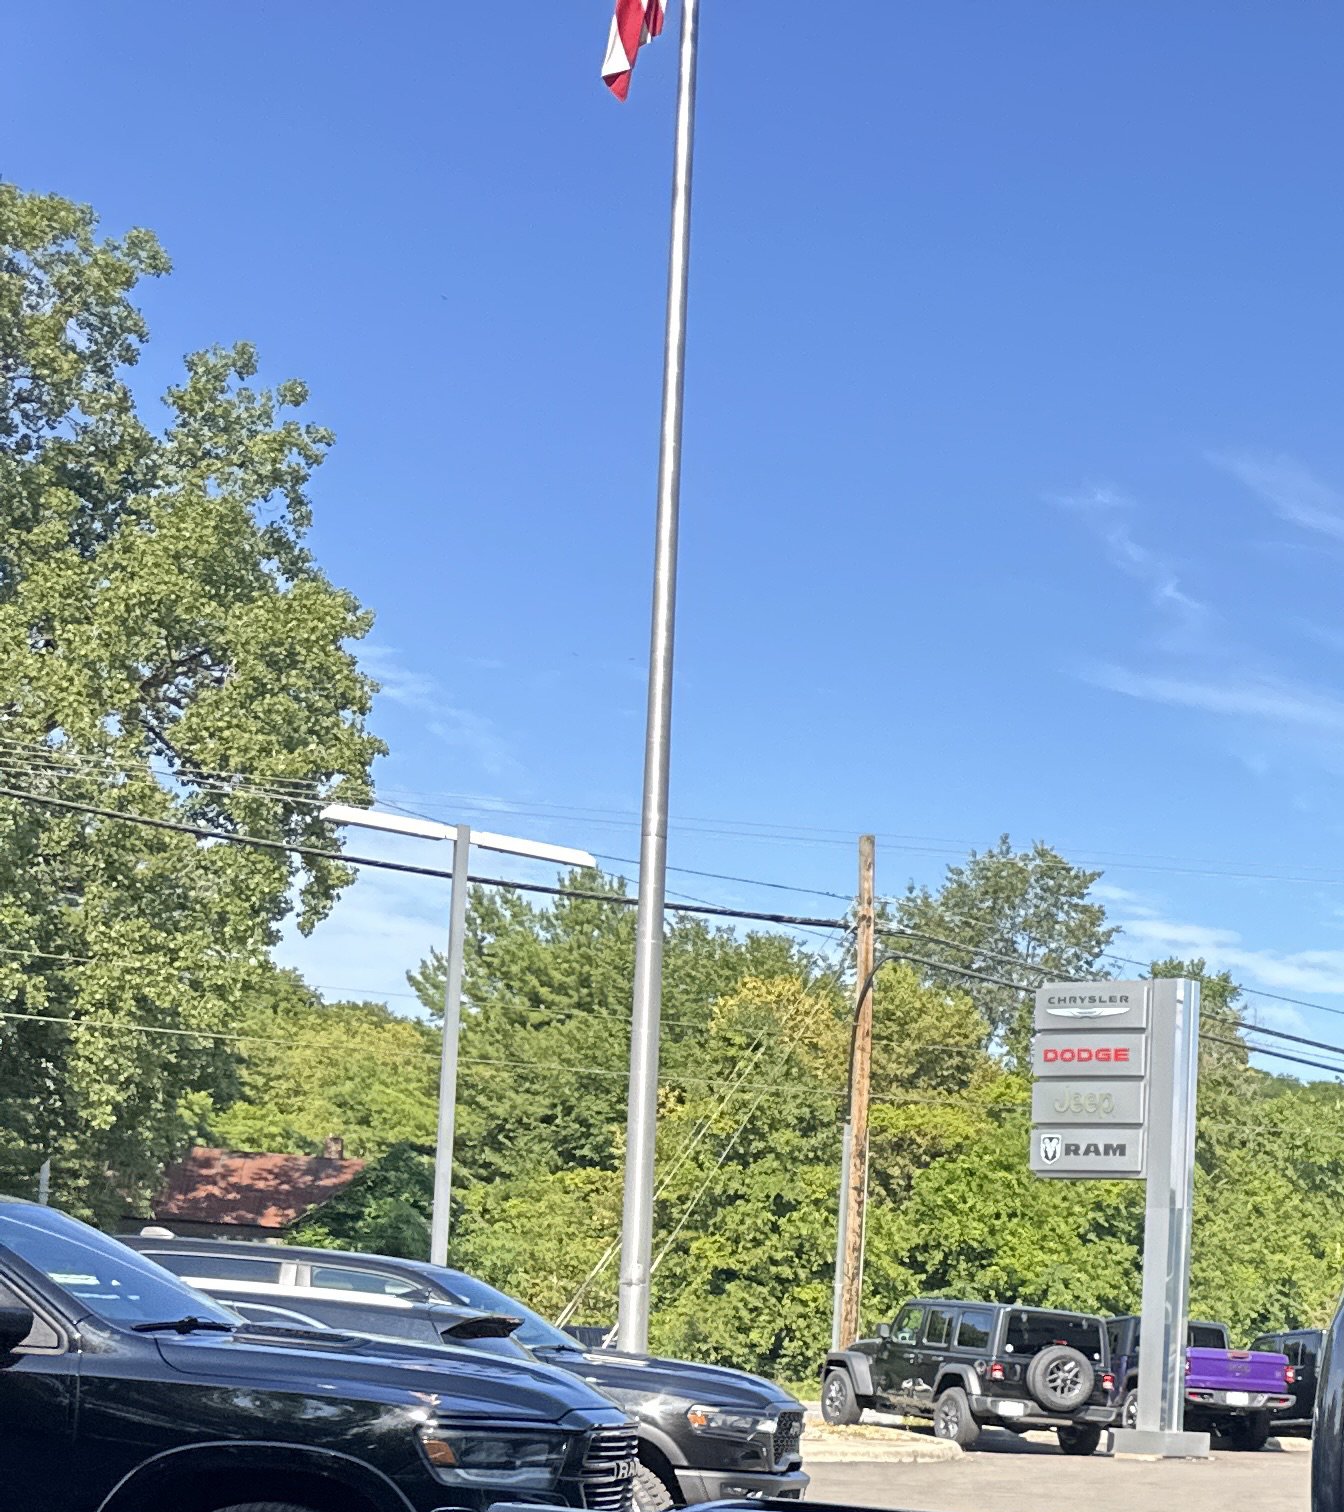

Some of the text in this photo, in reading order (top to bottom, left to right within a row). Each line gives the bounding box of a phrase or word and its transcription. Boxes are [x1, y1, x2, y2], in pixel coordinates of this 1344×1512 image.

[1047, 995, 1130, 1005] CHRYSLER
[1043, 1048, 1130, 1062] DODGE
[1053, 1086, 1115, 1119] Jeep
[1064, 1143, 1127, 1156] RAM
